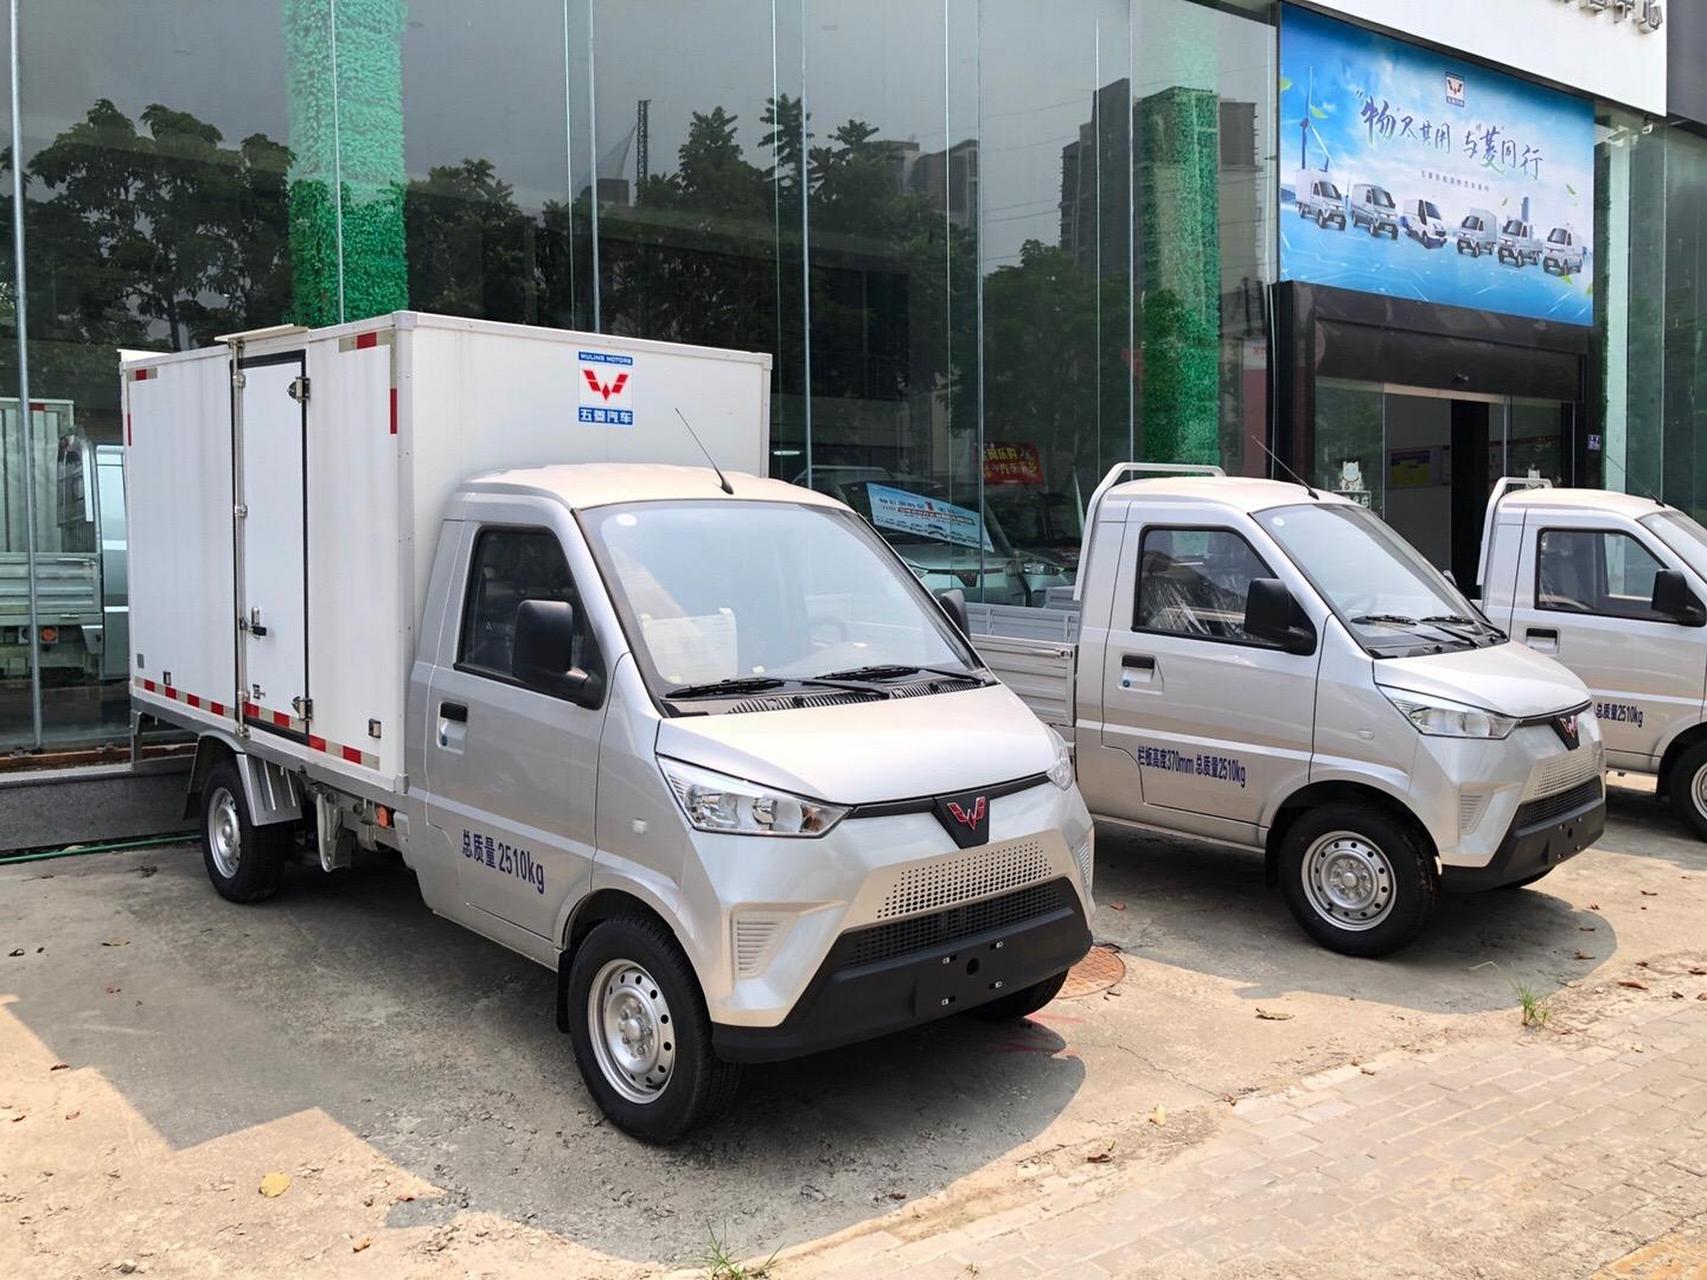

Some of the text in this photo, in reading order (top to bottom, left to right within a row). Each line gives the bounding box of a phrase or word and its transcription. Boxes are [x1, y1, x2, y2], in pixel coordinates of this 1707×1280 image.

[1595, 702, 1643, 728] 总质量2510kg
[1195, 753, 1246, 788] 总质量2510kg
[462, 828, 545, 894] 总质量2510kg
